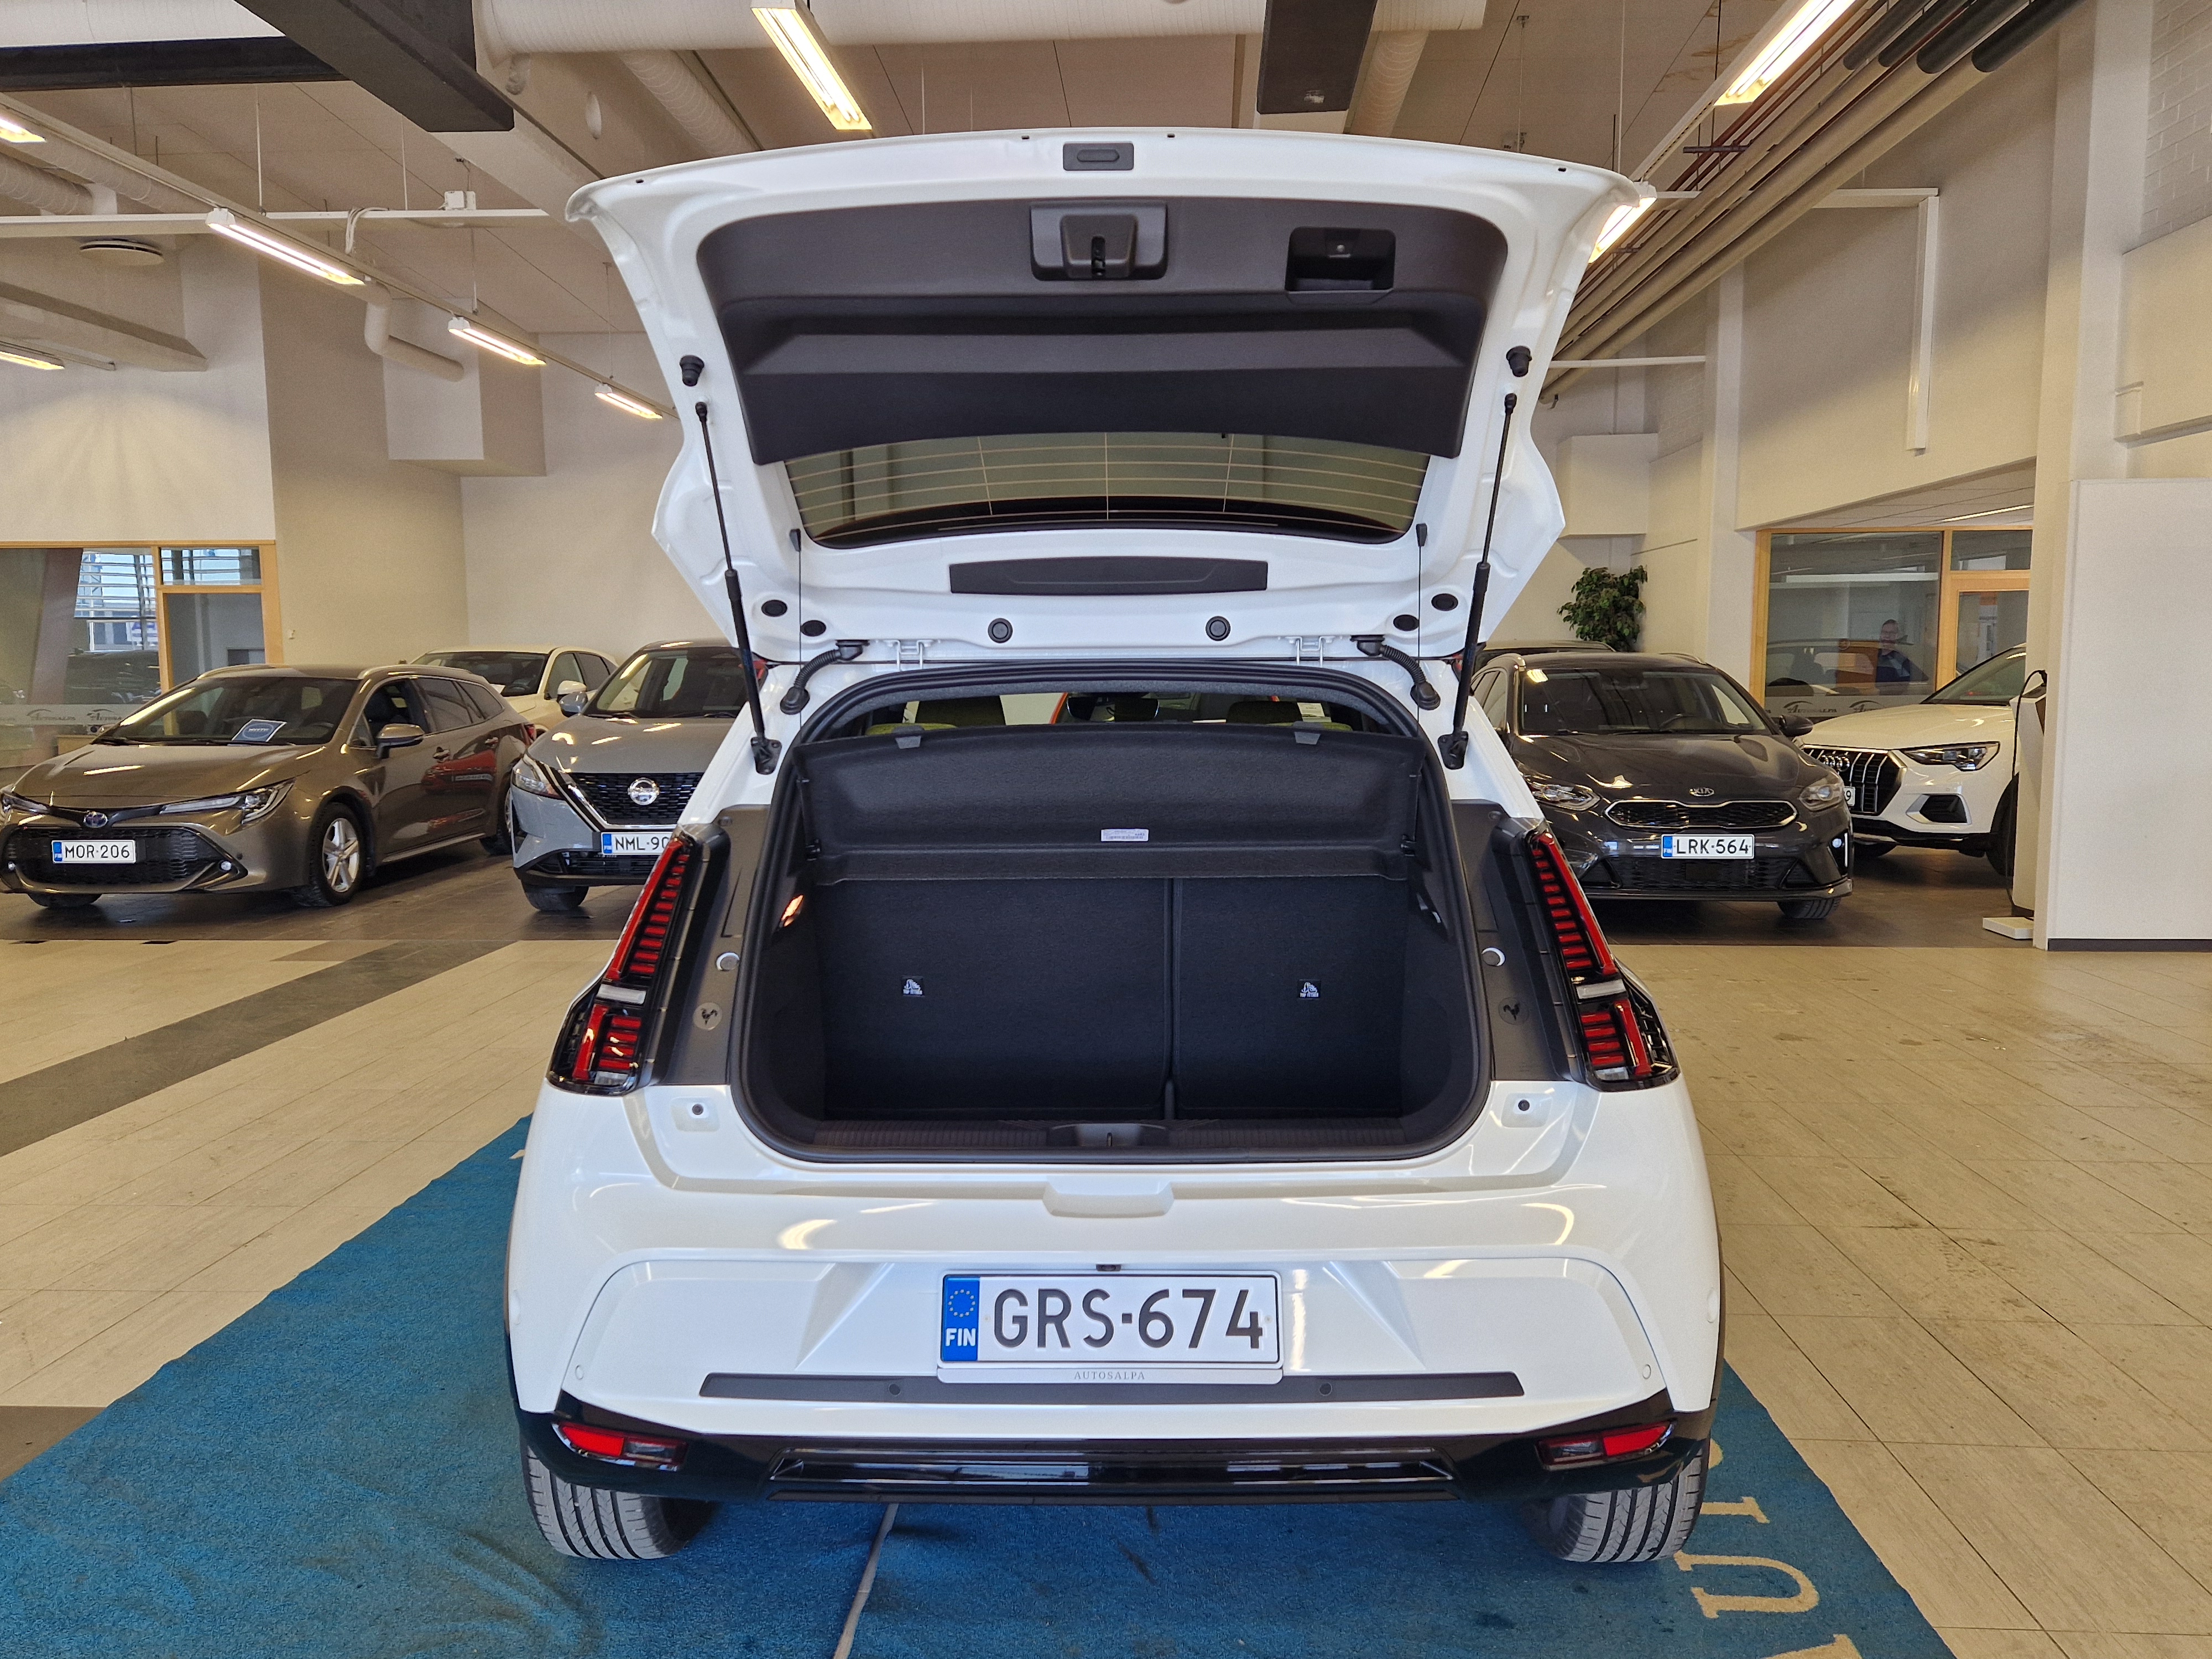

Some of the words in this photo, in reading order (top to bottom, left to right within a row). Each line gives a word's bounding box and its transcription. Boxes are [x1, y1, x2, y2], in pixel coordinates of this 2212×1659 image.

[615, 837, 670, 851] NML-90
[1677, 839, 1749, 854] LRK-564
[65, 845, 129, 858] MOR-206
[994, 1288, 1263, 1349] GRS-674
[945, 1328, 976, 1347] FIN
[1074, 1371, 1145, 1380] AUTOSALPA
